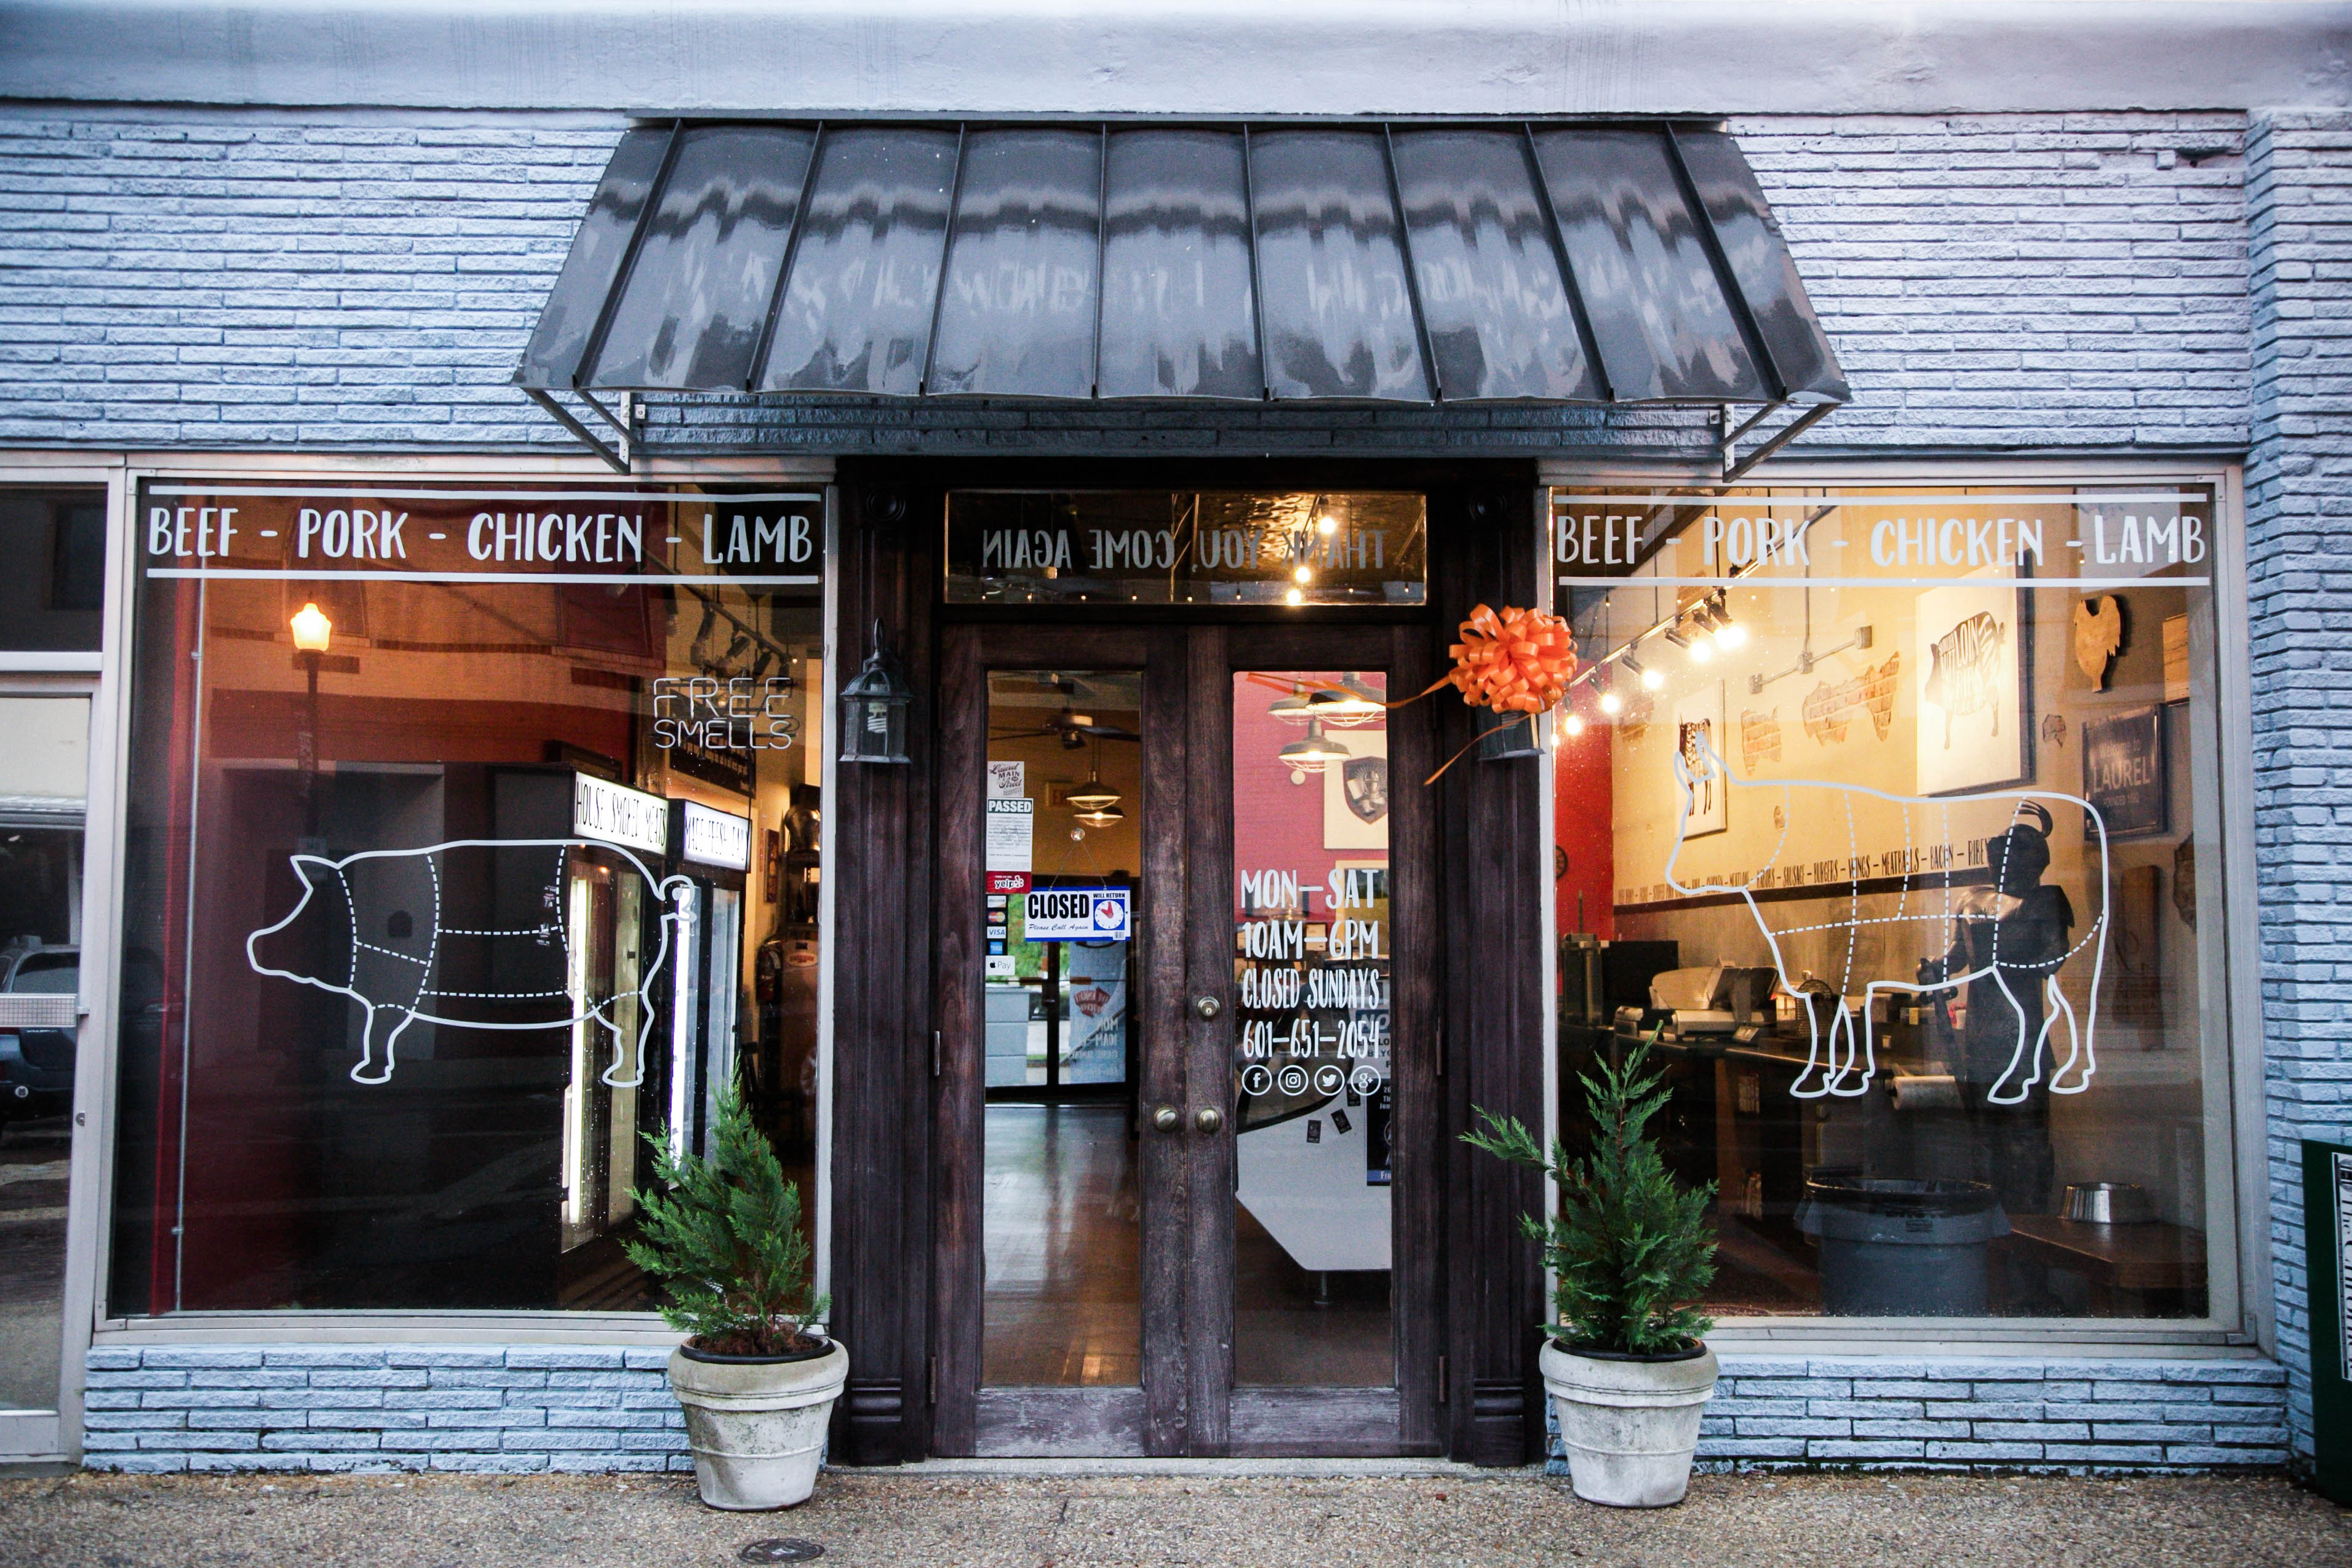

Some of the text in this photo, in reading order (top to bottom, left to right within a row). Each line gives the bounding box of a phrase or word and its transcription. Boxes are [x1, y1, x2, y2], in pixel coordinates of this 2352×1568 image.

[149, 507, 239, 557] BEEF
[298, 509, 408, 559] PORK
[468, 512, 643, 563] CHICKEN
[703, 514, 812, 563] LAMB
[1557, 515, 1643, 565] BEEF
[1704, 517, 1811, 567] PORK
[1870, 518, 2043, 567] CHICKEN
[2094, 515, 2206, 565] LAMB
[653, 677, 792, 718] FREE
[654, 719, 792, 750] SMELLS
[999, 771, 1019, 779] MAIN
[2093, 757, 2150, 794] LAUREL
[576, 781, 604, 830] HOUSE
[988, 800, 1032, 812] PASSED
[995, 879, 1014, 889] yelp
[1240, 868, 1379, 909] MON-SAT
[1783, 864, 1805, 887] SAUSAGE
[1813, 859, 1838, 883] BURGERS
[1848, 854, 1871, 879] WNGS
[1028, 894, 1089, 919] CLOSED
[1242, 920, 1379, 960] 10AM-6PM
[997, 961, 1011, 971] Pay
[1242, 967, 1380, 1009] CLOSED SUNDAYS
[1243, 1019, 1380, 1059] 601-651-2054
